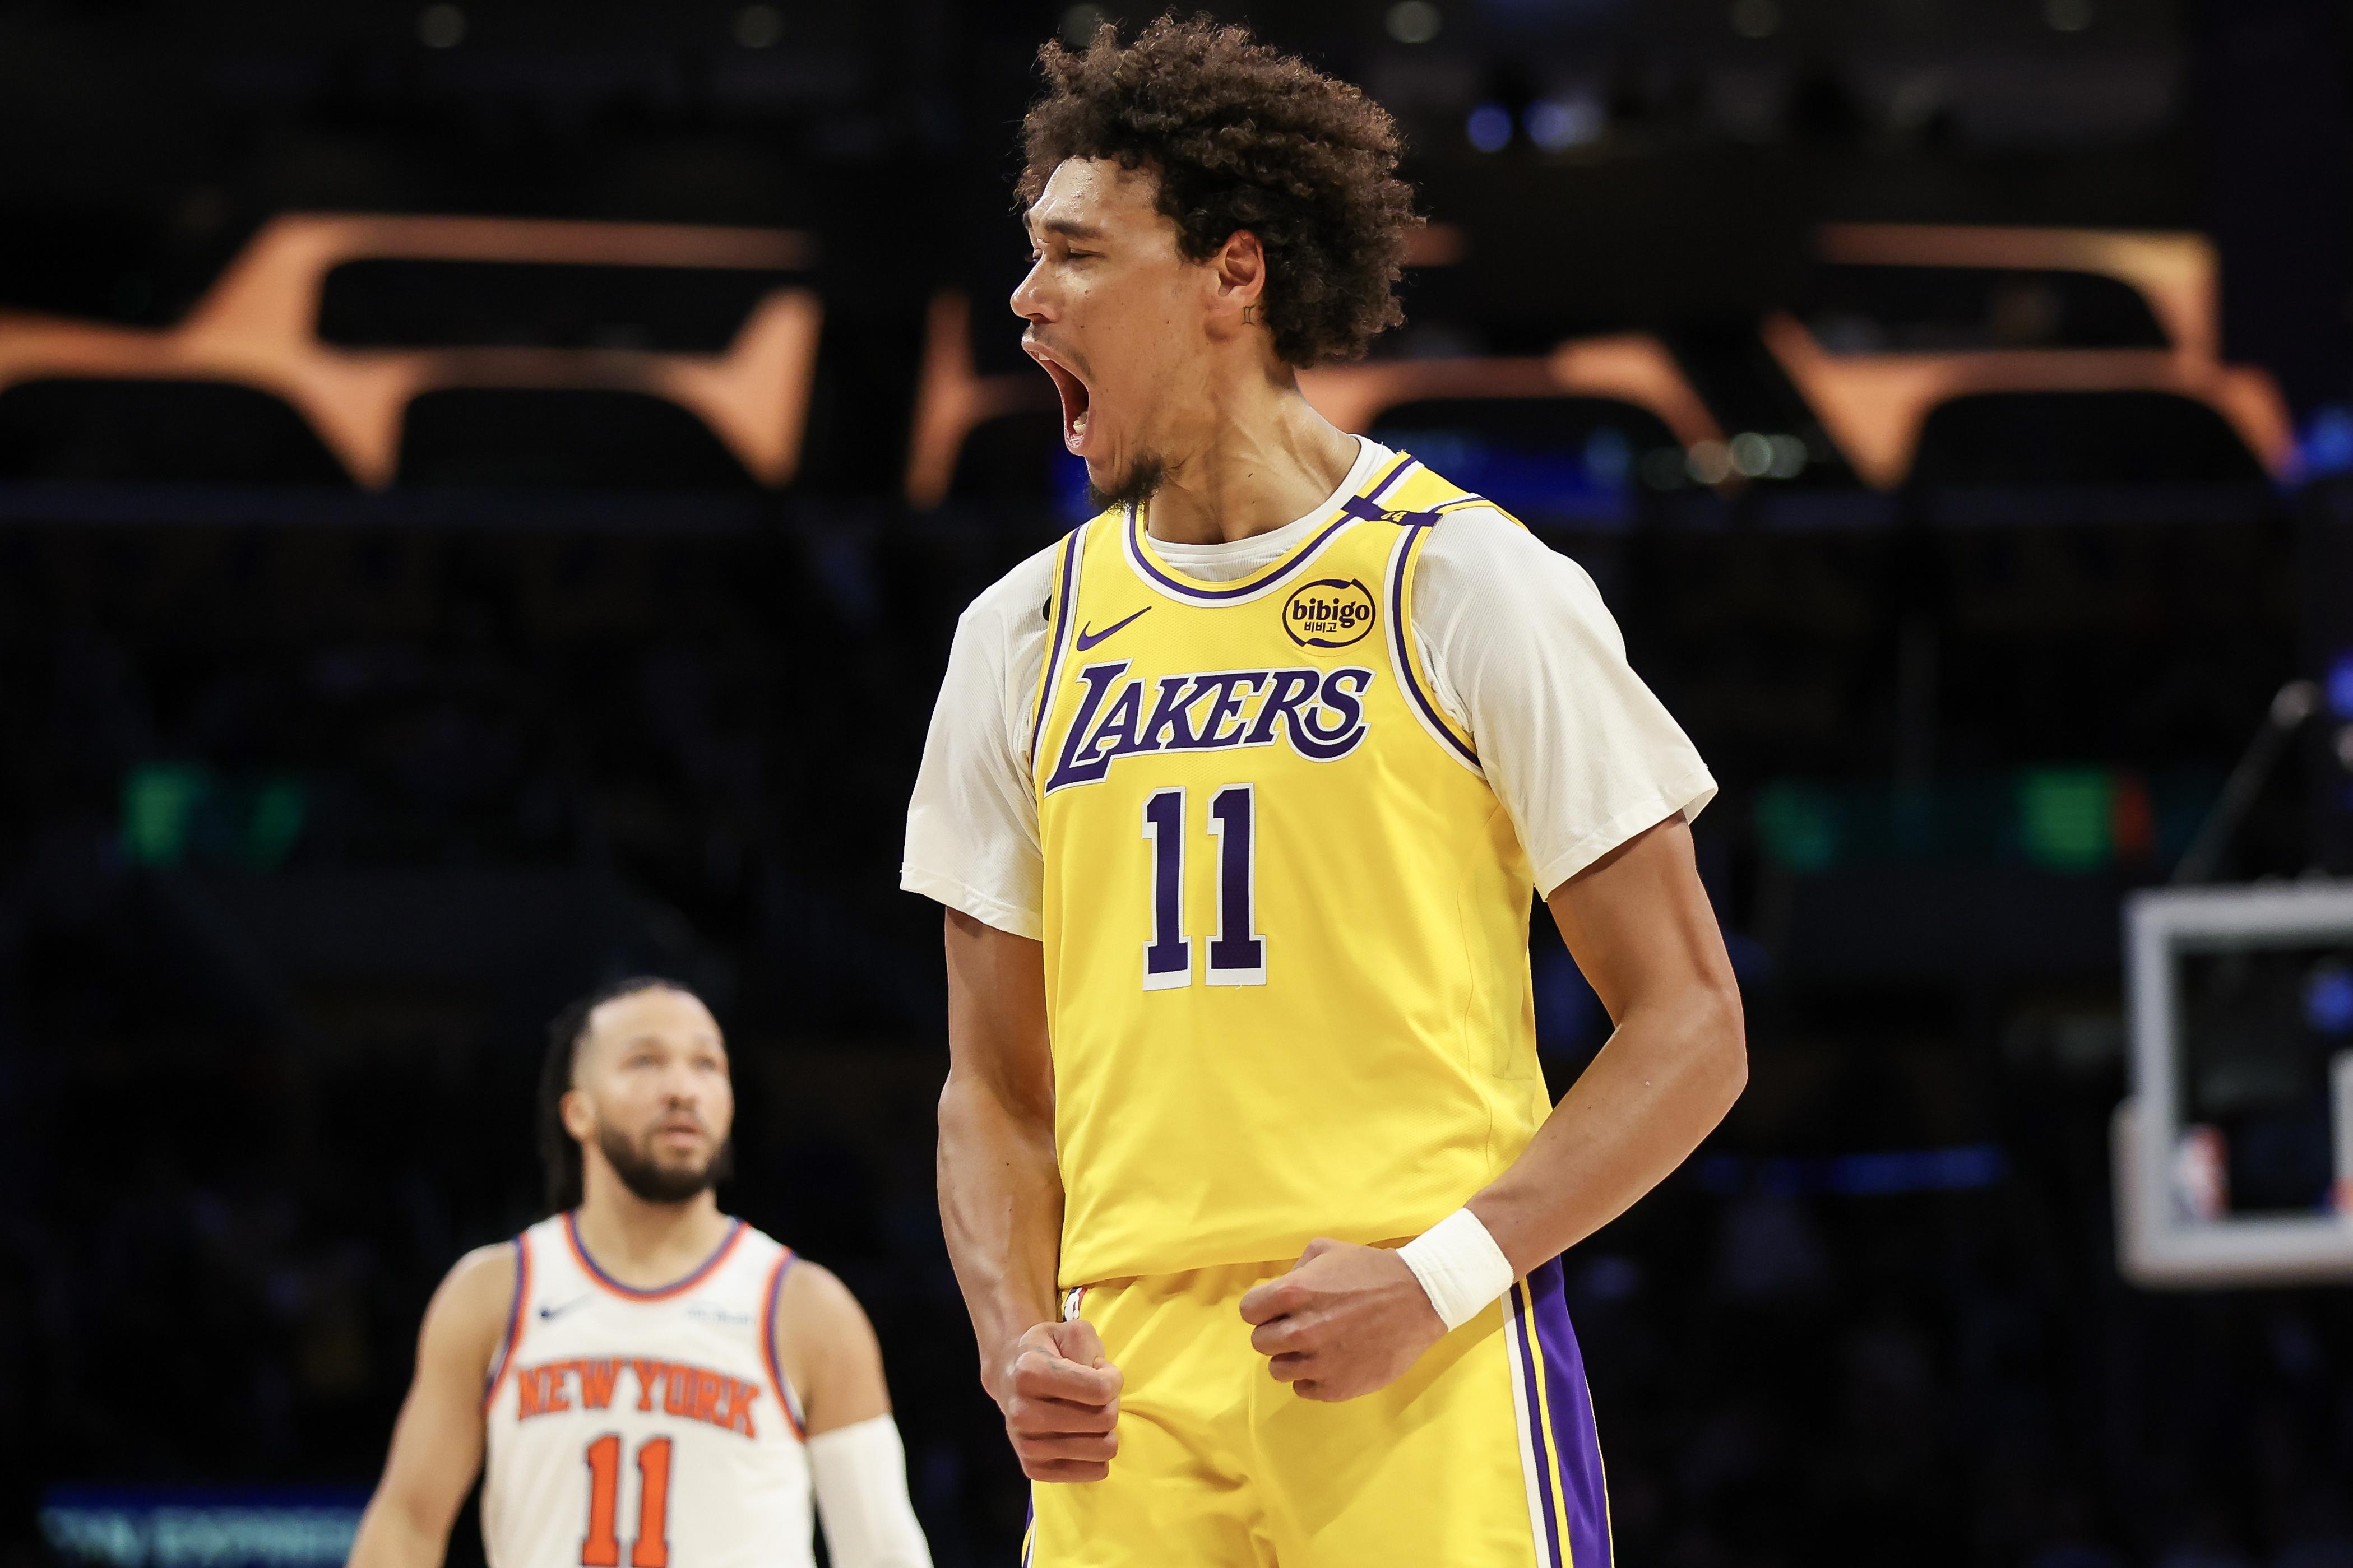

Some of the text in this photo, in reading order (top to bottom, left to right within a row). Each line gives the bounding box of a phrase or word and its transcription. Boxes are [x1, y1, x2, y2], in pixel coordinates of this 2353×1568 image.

[1292, 598, 1370, 628] bibigo
[1304, 621, 1337, 633] 비비고
[1044, 658, 1377, 798] LAKERS
[1141, 782, 1267, 991] 11
[518, 1357, 762, 1440] NEW YORK
[581, 1433, 673, 1568] 11
